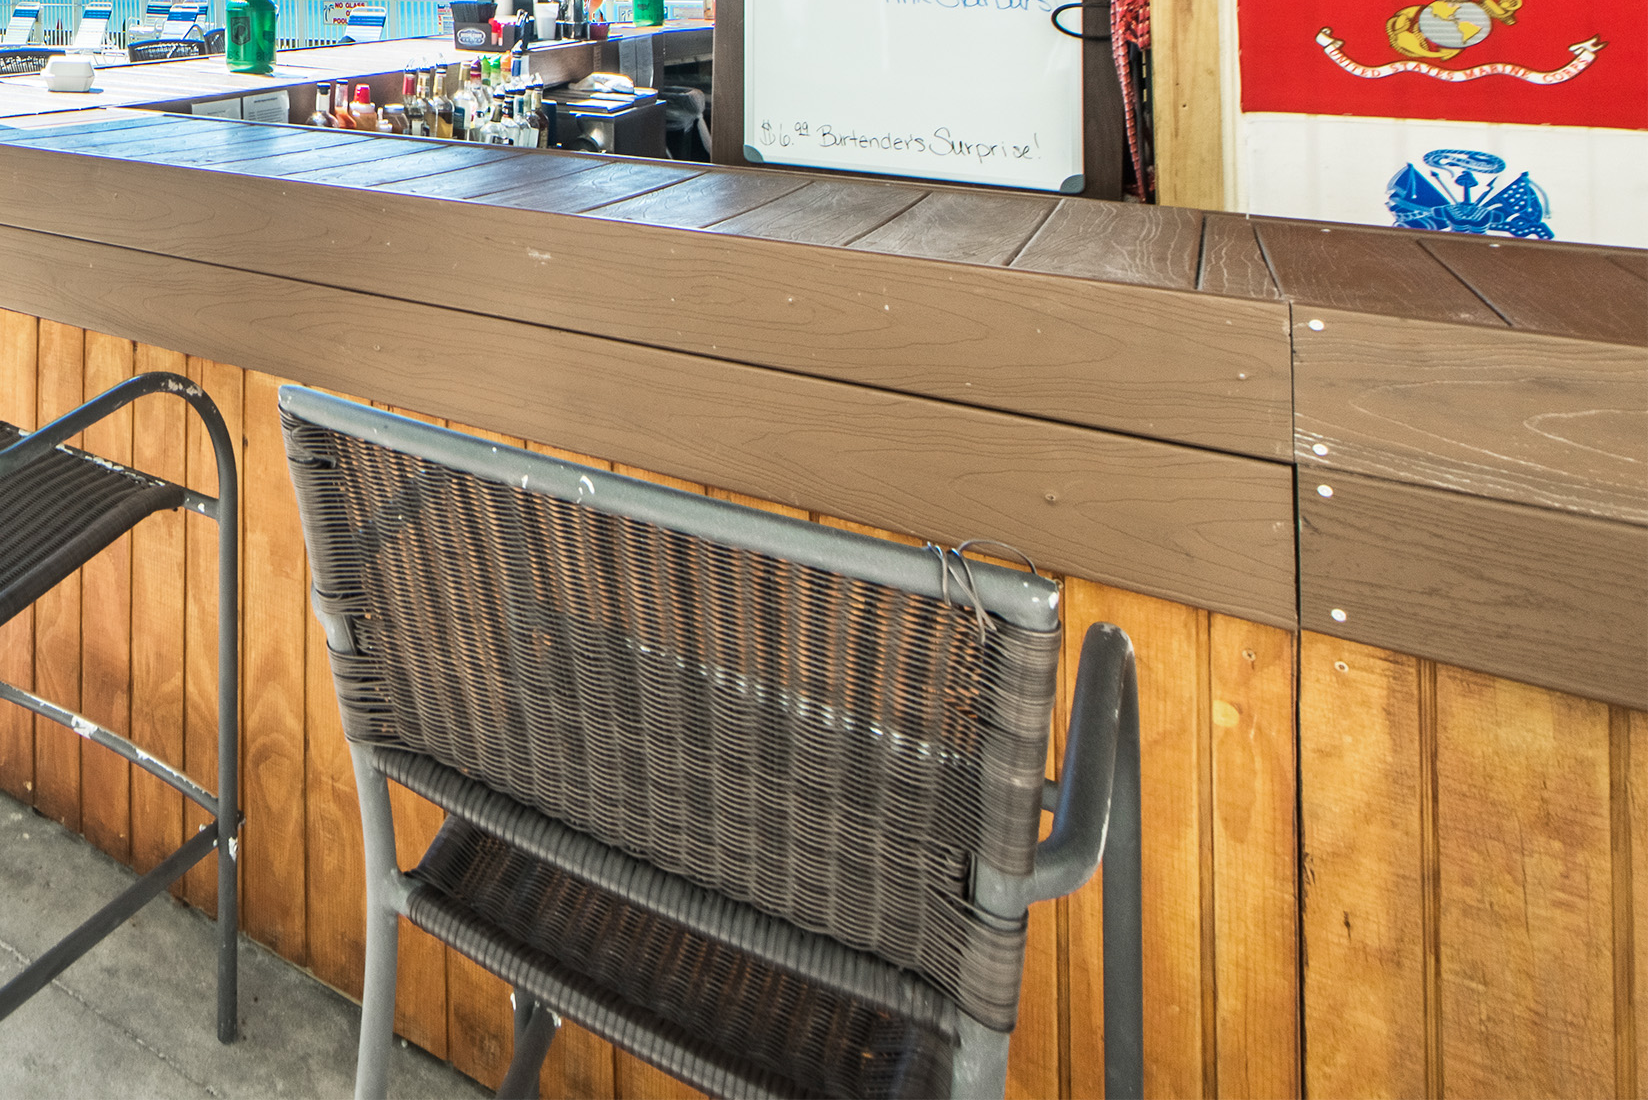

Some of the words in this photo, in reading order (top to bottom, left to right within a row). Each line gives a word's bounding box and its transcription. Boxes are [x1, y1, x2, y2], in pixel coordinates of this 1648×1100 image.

[1329, 48, 1381, 77] UNITED
[1390, 62, 1454, 81] STATES
[1464, 63, 1530, 80] MARINE
[1542, 57, 1590, 83] CORPS
